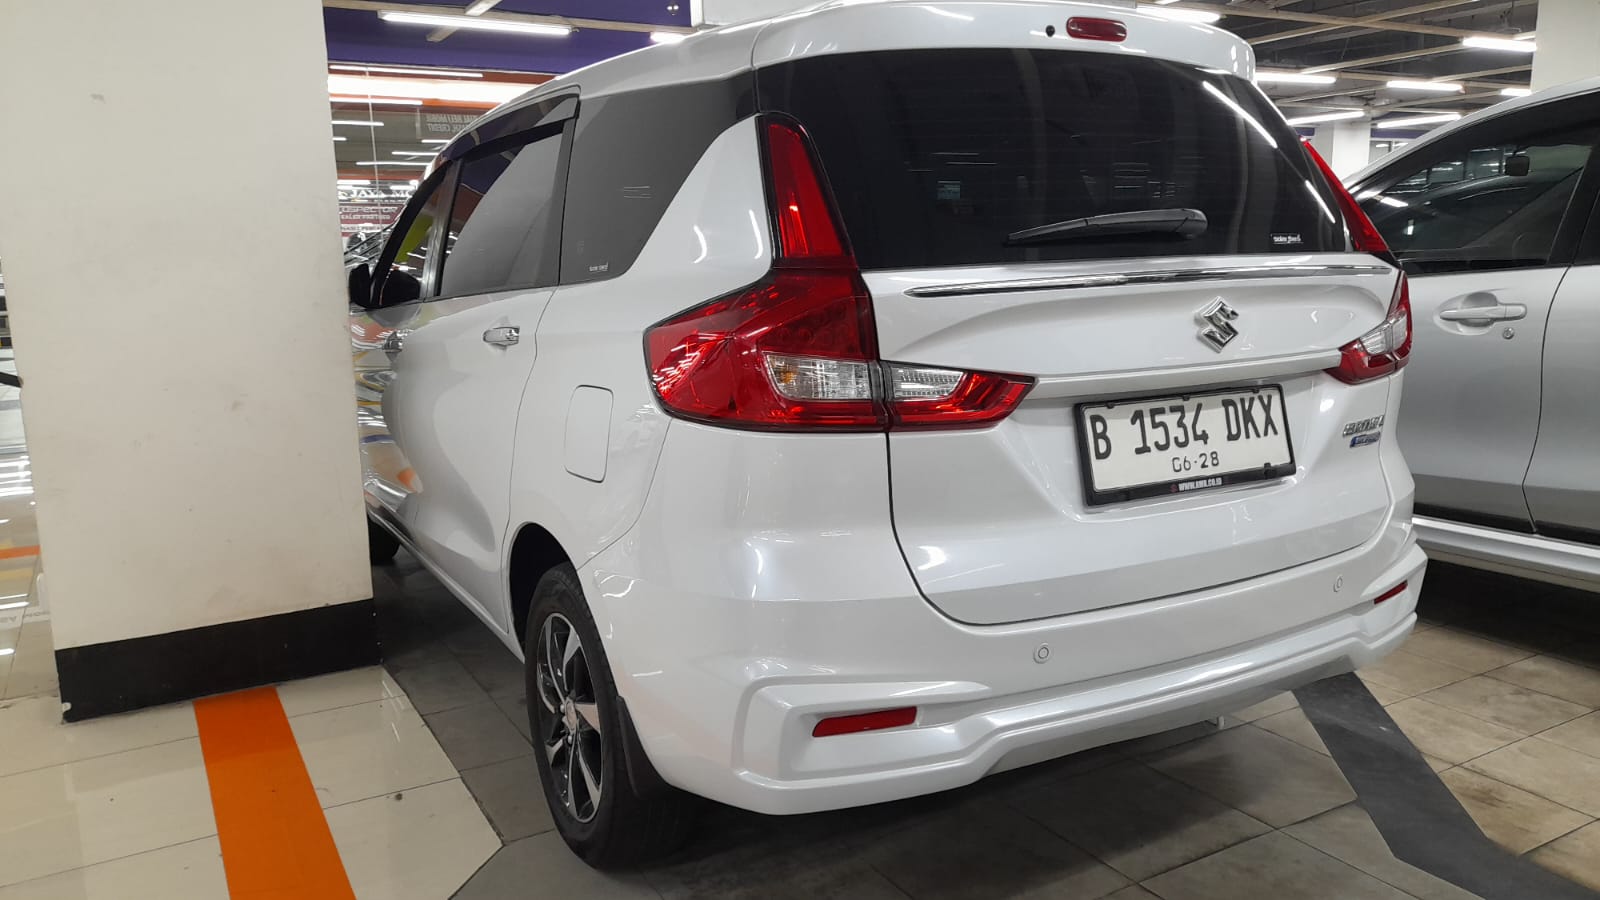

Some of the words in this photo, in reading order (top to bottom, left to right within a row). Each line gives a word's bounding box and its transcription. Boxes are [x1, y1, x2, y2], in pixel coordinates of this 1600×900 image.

[1089, 414, 1112, 460] B
[1130, 403, 1209, 455] 1534
[1221, 394, 1278, 441] DKX
